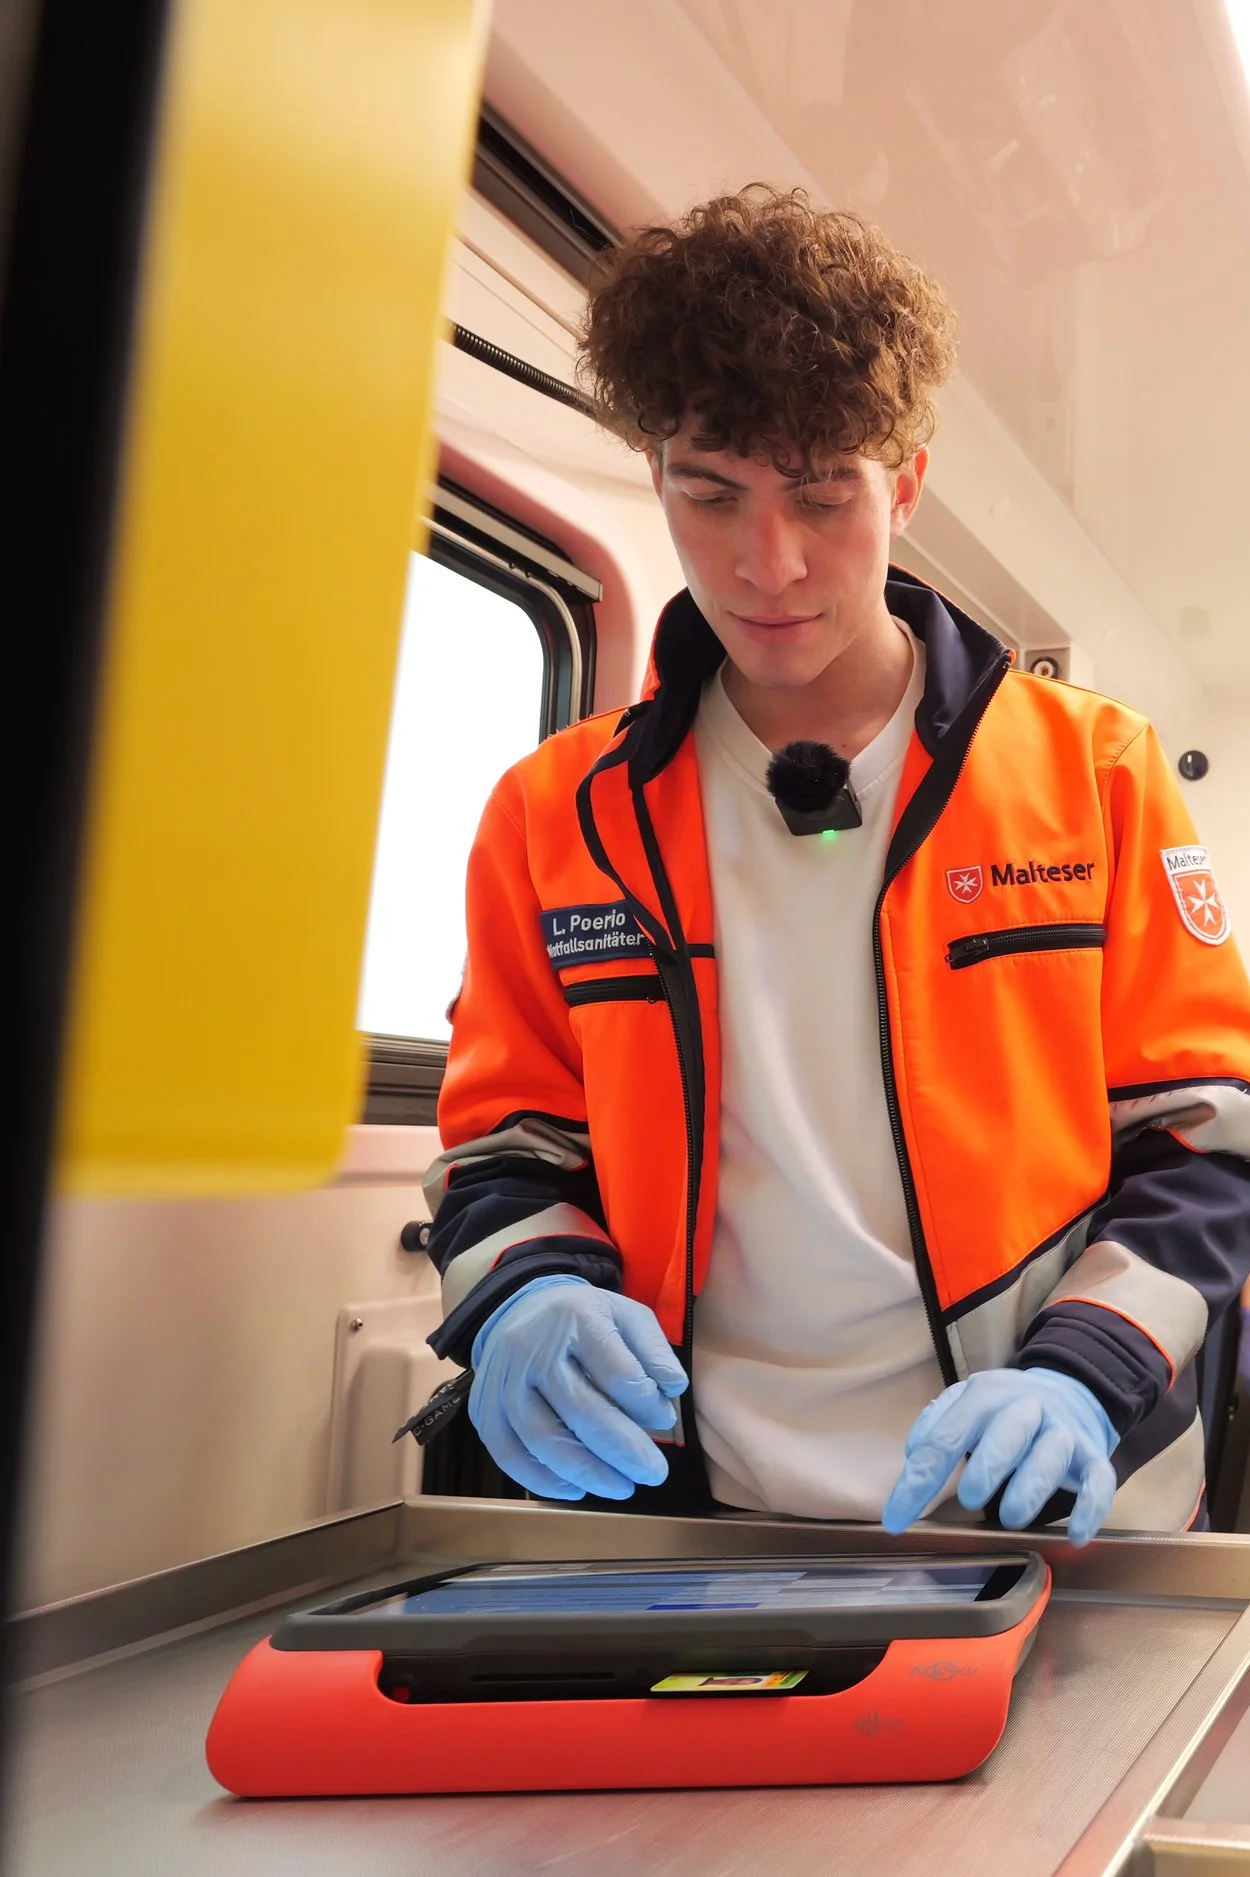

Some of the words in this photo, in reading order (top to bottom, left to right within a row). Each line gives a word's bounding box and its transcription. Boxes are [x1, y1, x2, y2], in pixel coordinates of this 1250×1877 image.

[990, 861, 1095, 887] Malteser
[552, 918, 566, 936] L.
[570, 909, 626, 932] Poerio
